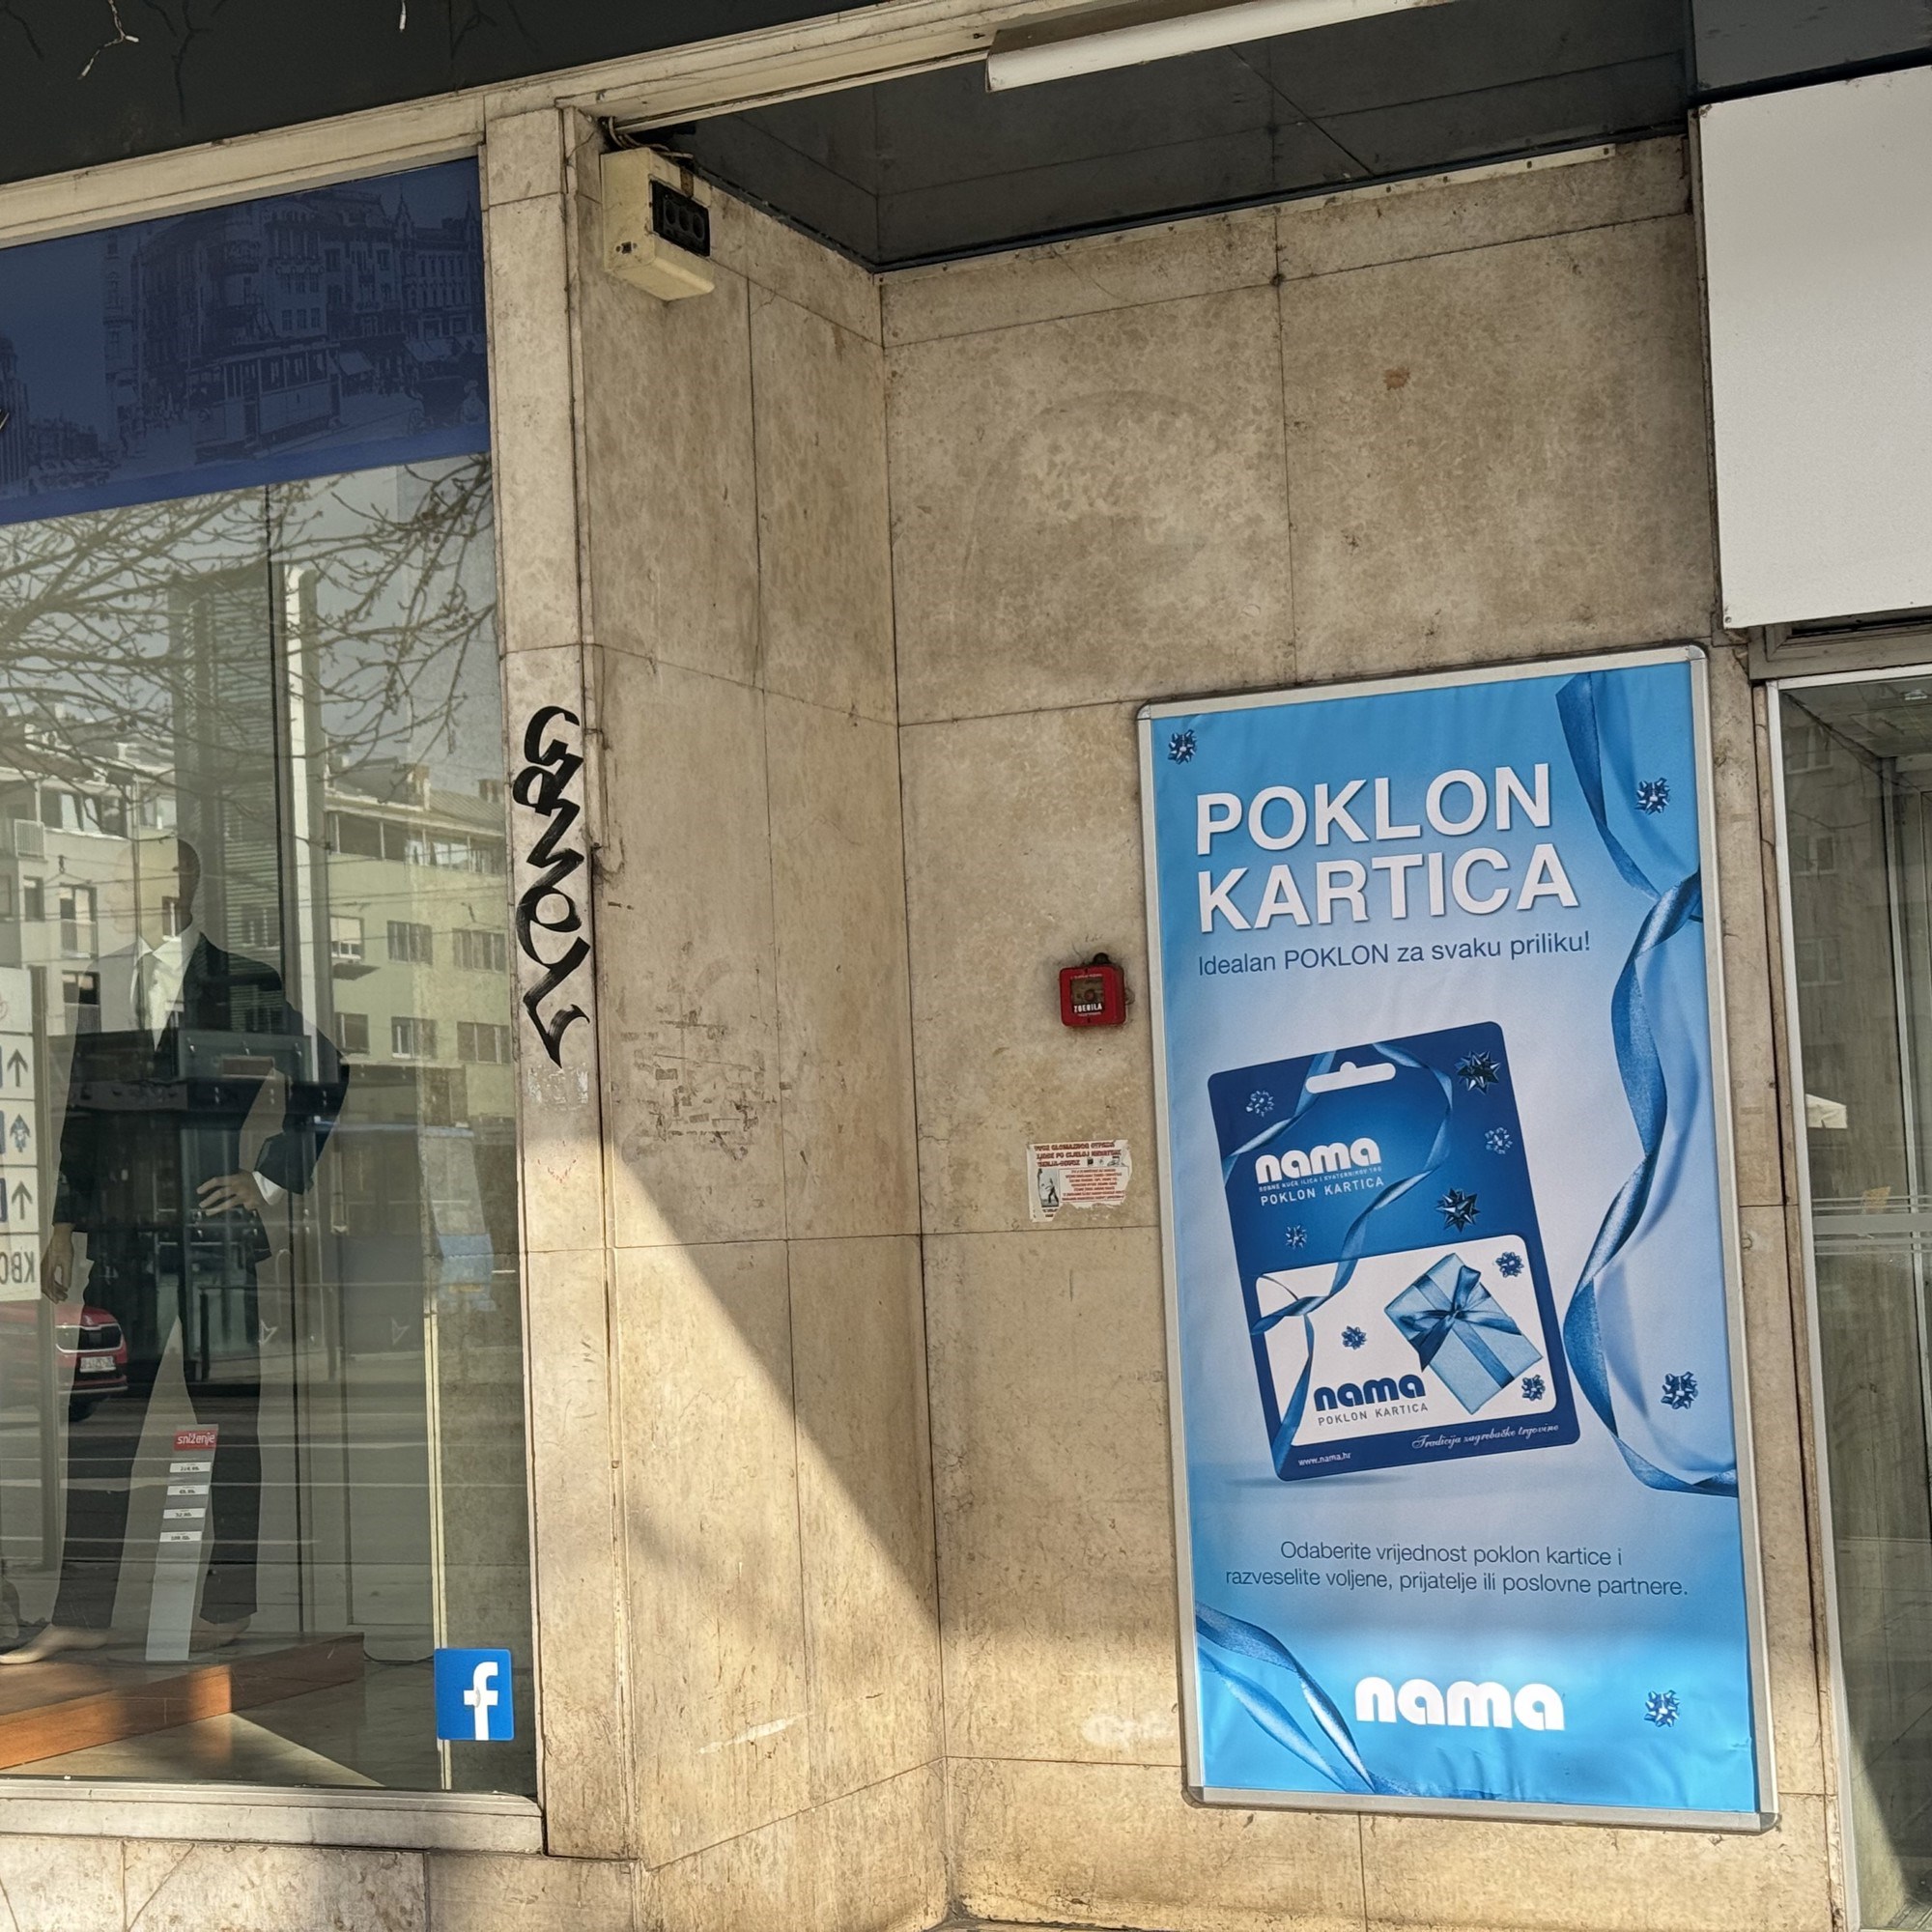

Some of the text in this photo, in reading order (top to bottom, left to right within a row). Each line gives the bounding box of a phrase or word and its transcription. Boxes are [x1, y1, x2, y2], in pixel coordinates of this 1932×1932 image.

[1196, 763, 1550, 856] POKLON
[1198, 843, 1578, 933] KARTICA
[1199, 930, 1591, 976] Idealan POKLON za svaku priliku!
[1255, 1137, 1381, 1183] nama
[1261, 1177, 1384, 1207] POKLON KARTICA
[1313, 1374, 1426, 1411] nama
[1318, 1403, 1429, 1427] POKLON KARTICA
[1297, 1451, 1352, 1467] www.nama.hr
[1411, 1434, 1462, 1450] Tradicija
[1280, 1540, 1622, 1567] Odaberite vrijednost poklon kartice i
[1225, 1567, 1689, 1598] razveselite voljene, prijatelje ili poslovne partnere.
[1354, 1675, 1565, 1731] nama
